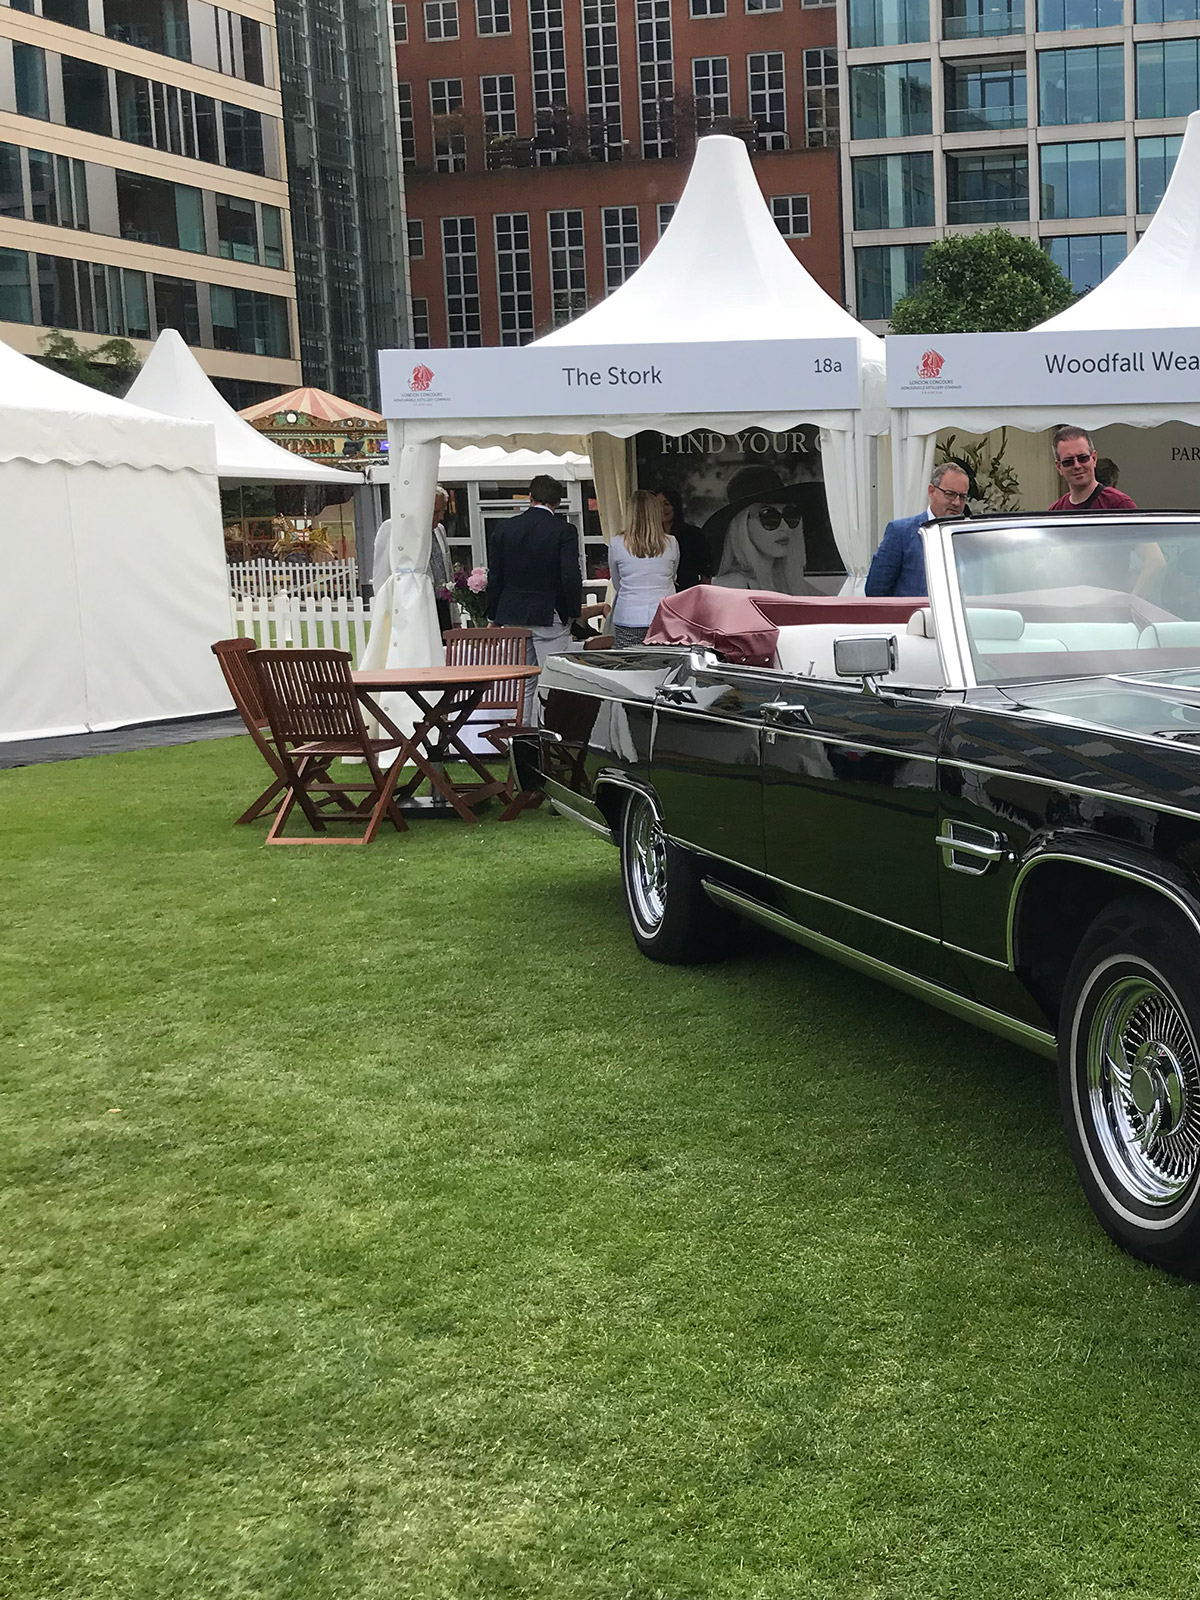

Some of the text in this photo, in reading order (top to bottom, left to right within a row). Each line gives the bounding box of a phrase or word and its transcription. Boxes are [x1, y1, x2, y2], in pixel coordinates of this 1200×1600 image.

[813, 358, 843, 373] 18a
[1044, 352, 1145, 374] Woodfall
[561, 365, 663, 386] The Stork
[659, 433, 727, 454] FIND
[734, 432, 809, 454] YOUR
